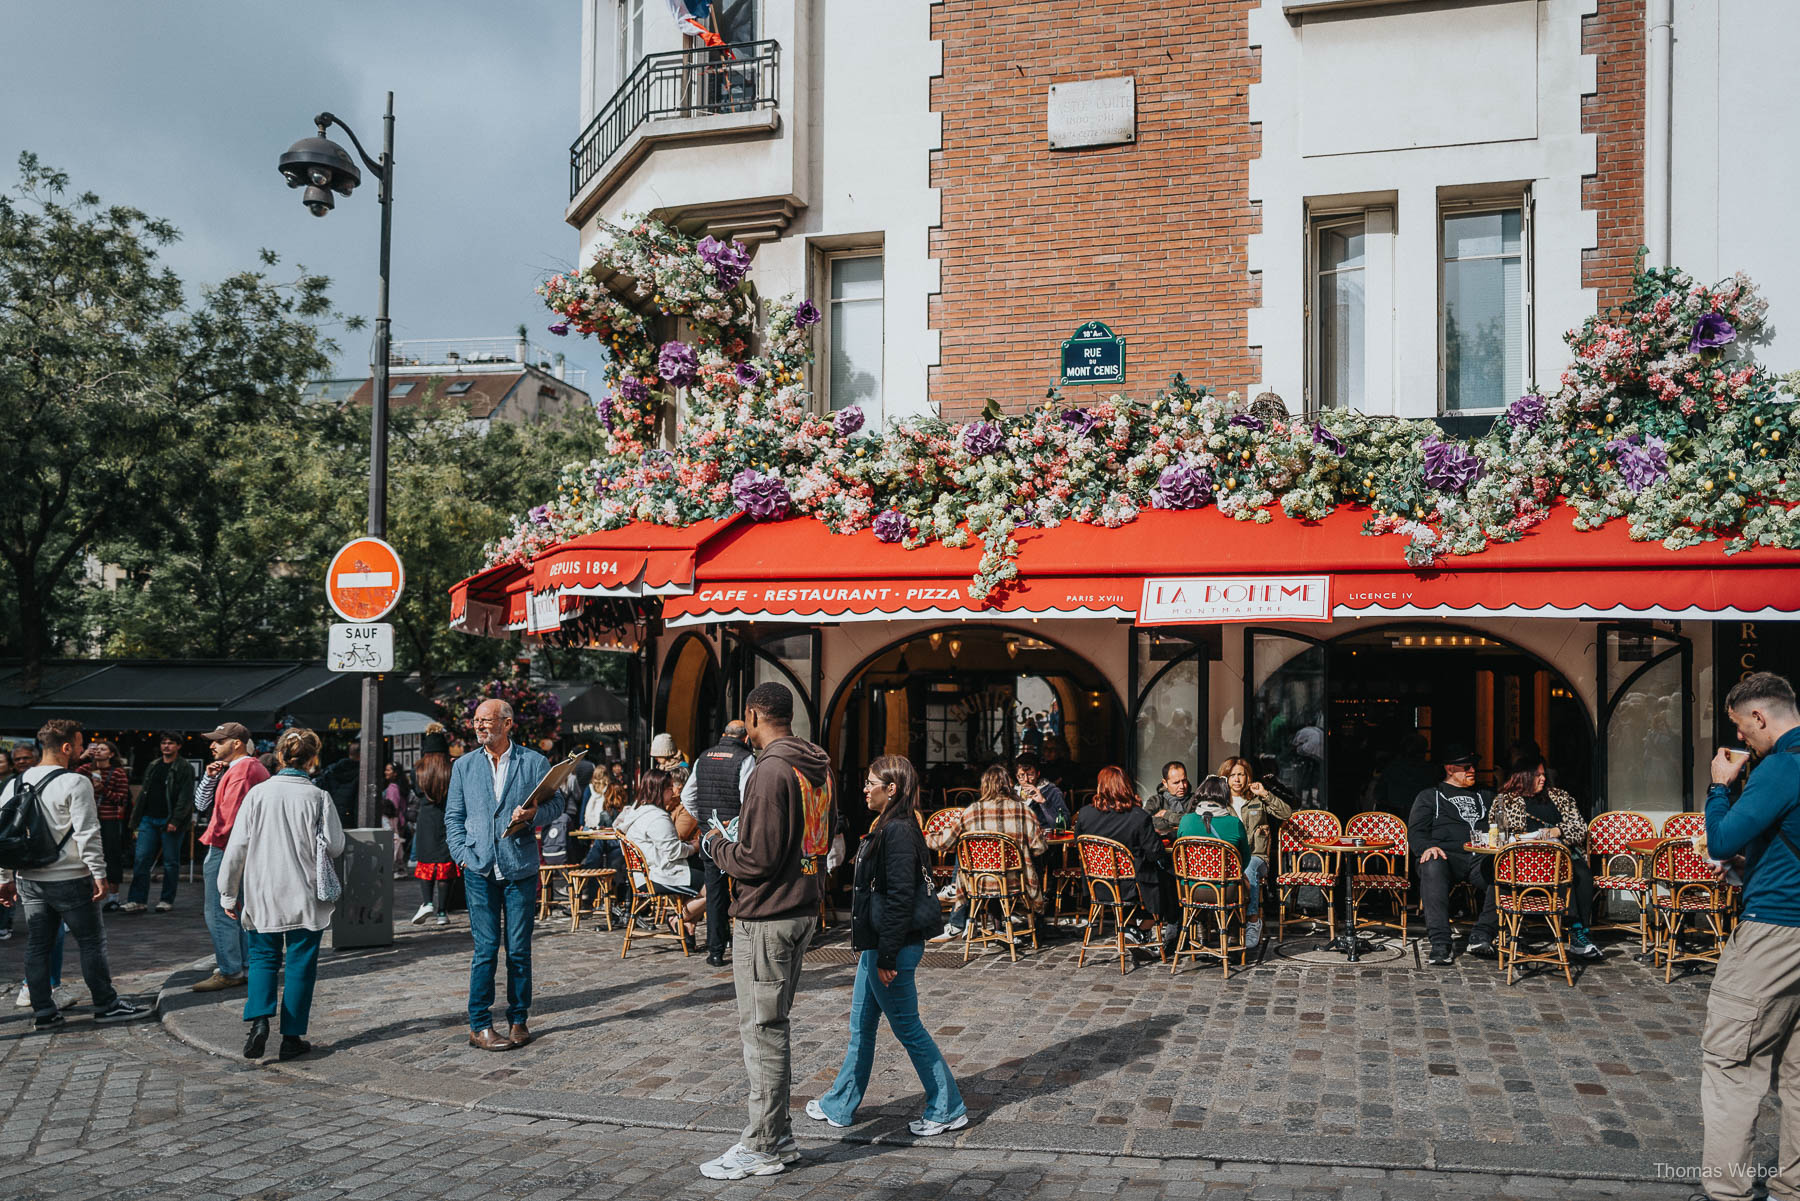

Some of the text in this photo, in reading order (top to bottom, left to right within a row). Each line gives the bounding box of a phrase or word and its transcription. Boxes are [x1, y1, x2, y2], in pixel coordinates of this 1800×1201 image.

[1084, 347, 1102, 358] RUE
[1066, 364, 1119, 377] MONT CENIS
[549, 561, 618, 577] DEPUIS 1894
[699, 588, 960, 602] CAFE RESTAURANT PIZZA
[1066, 595, 1125, 603] PARIS XVIII
[1156, 584, 1317, 605] LA BOHEME
[1349, 592, 1413, 600] LICENCE IV
[1171, 605, 1282, 615] MONTMARTRE
[345, 627, 378, 639] SAUF
